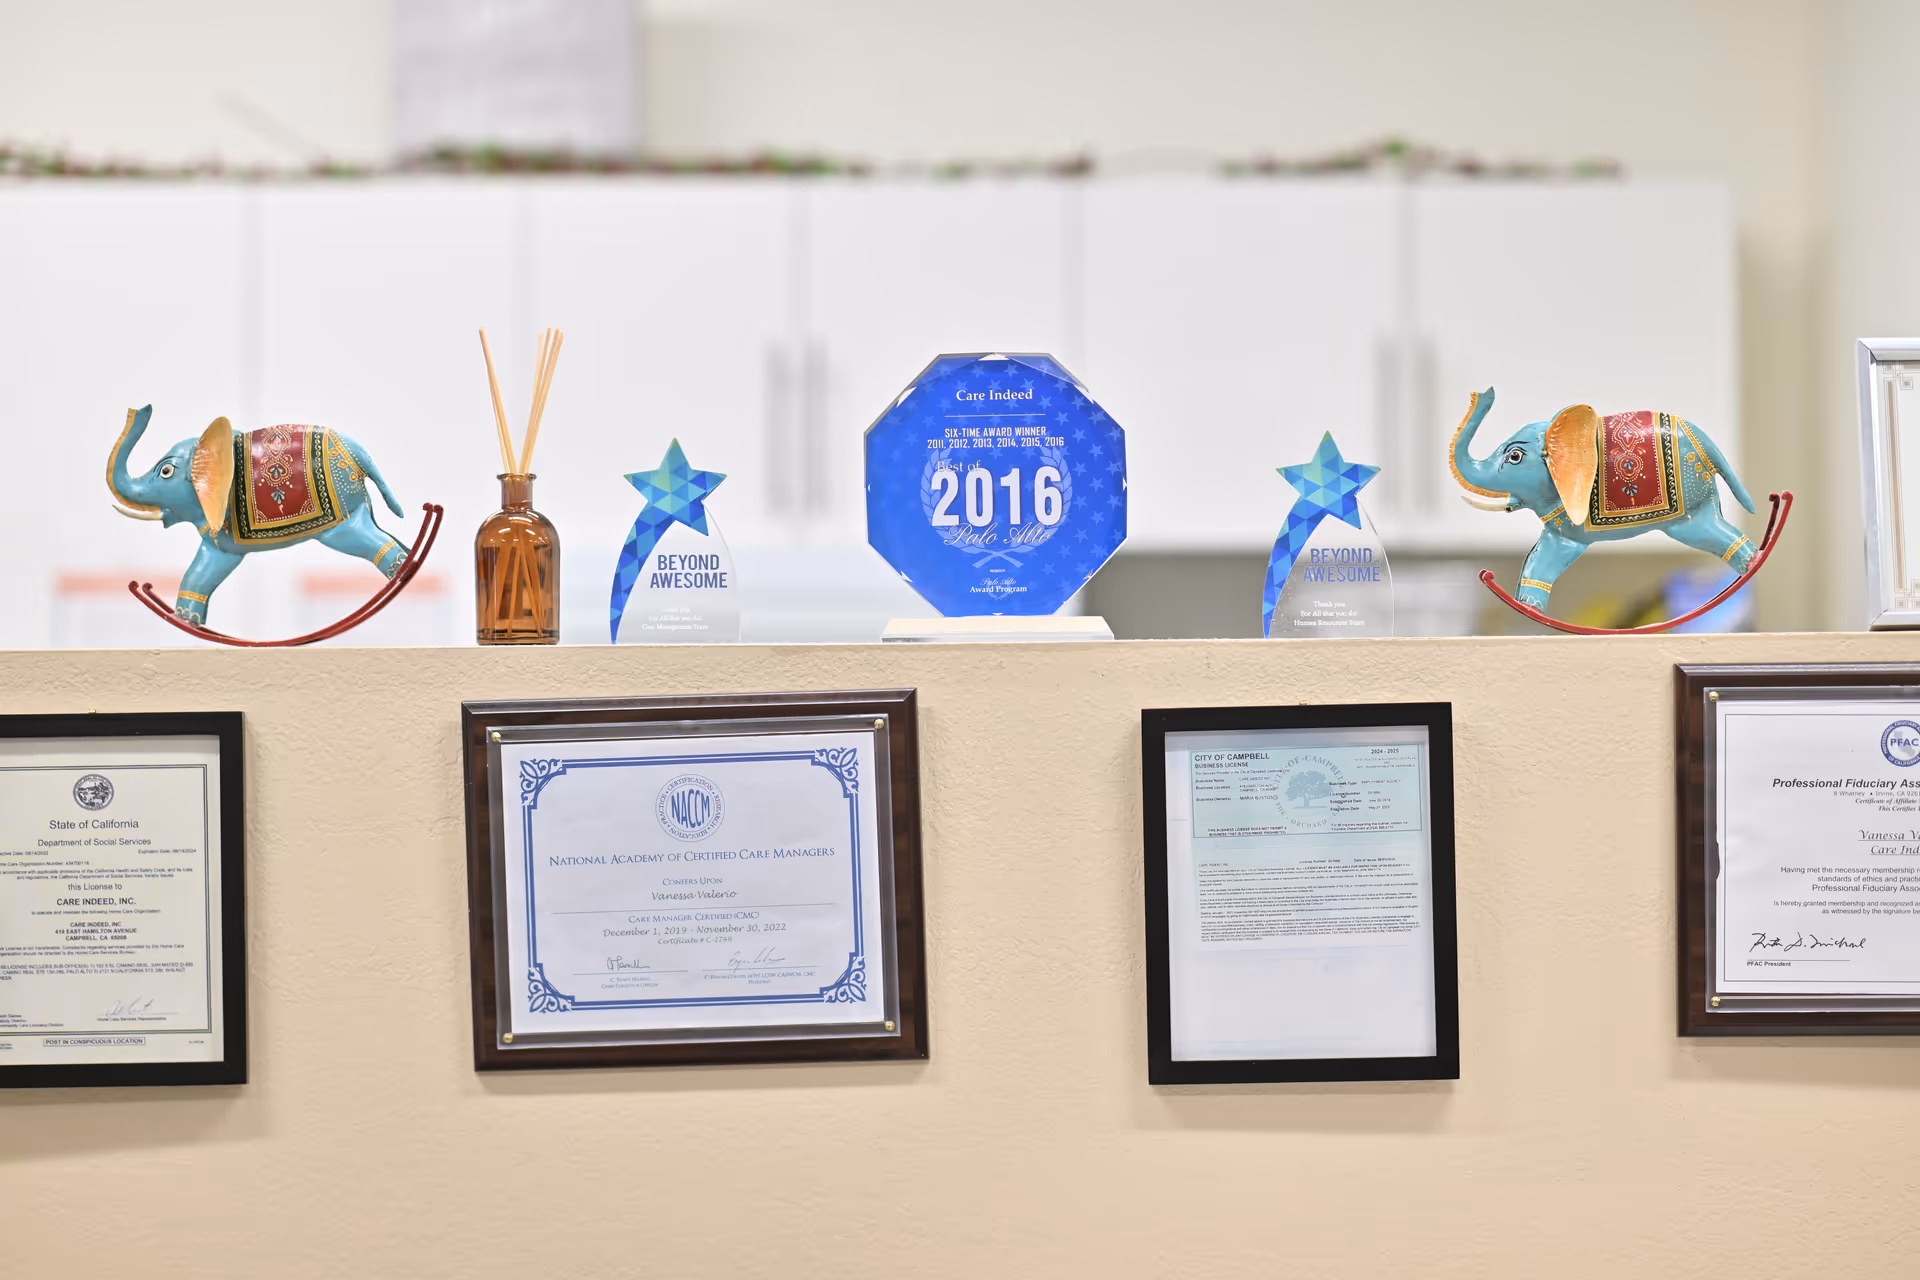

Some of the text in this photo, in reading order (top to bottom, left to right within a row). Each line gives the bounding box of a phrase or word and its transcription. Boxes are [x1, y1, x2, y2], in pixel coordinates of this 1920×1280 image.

[956, 388, 1033, 401] Care Indeed
[945, 426, 1046, 438] SIX-TIME AWARD WINNER
[927, 436, 1064, 449] 2011, 2012, 2013, 2014, 2015, 2016
[936, 460, 981, 473] Best of
[931, 465, 1064, 527] 2016
[943, 521, 1052, 546] Palo Alto
[657, 554, 720, 571] BEYOND
[1310, 548, 1372, 564] BEYOND
[650, 572, 728, 589] AWESOME
[1303, 566, 1381, 582] AWESOME
[996, 586, 1027, 594] Program
[1890, 738, 1919, 747] PFAC
[667, 777, 713, 791] CERTIFICATION
[1772, 778, 1842, 788] Professional
[1845, 778, 1897, 790] Fiduciary
[659, 793, 667, 825] PRACTICE
[671, 789, 710, 828] NACCM
[49, 819, 139, 829] State of California
[1859, 829, 1905, 840] Vanessa
[38, 838, 151, 847] Department of Social Services
[1870, 845, 1897, 854] Care
[68, 883, 122, 891] this License to
[1862, 885, 1897, 893] Fiduciary
[651, 890, 738, 900] Vanessa Valerio
[83, 898, 116, 906] INDEED,
[603, 922, 787, 938] December 1, 2019 November 30, 2022
